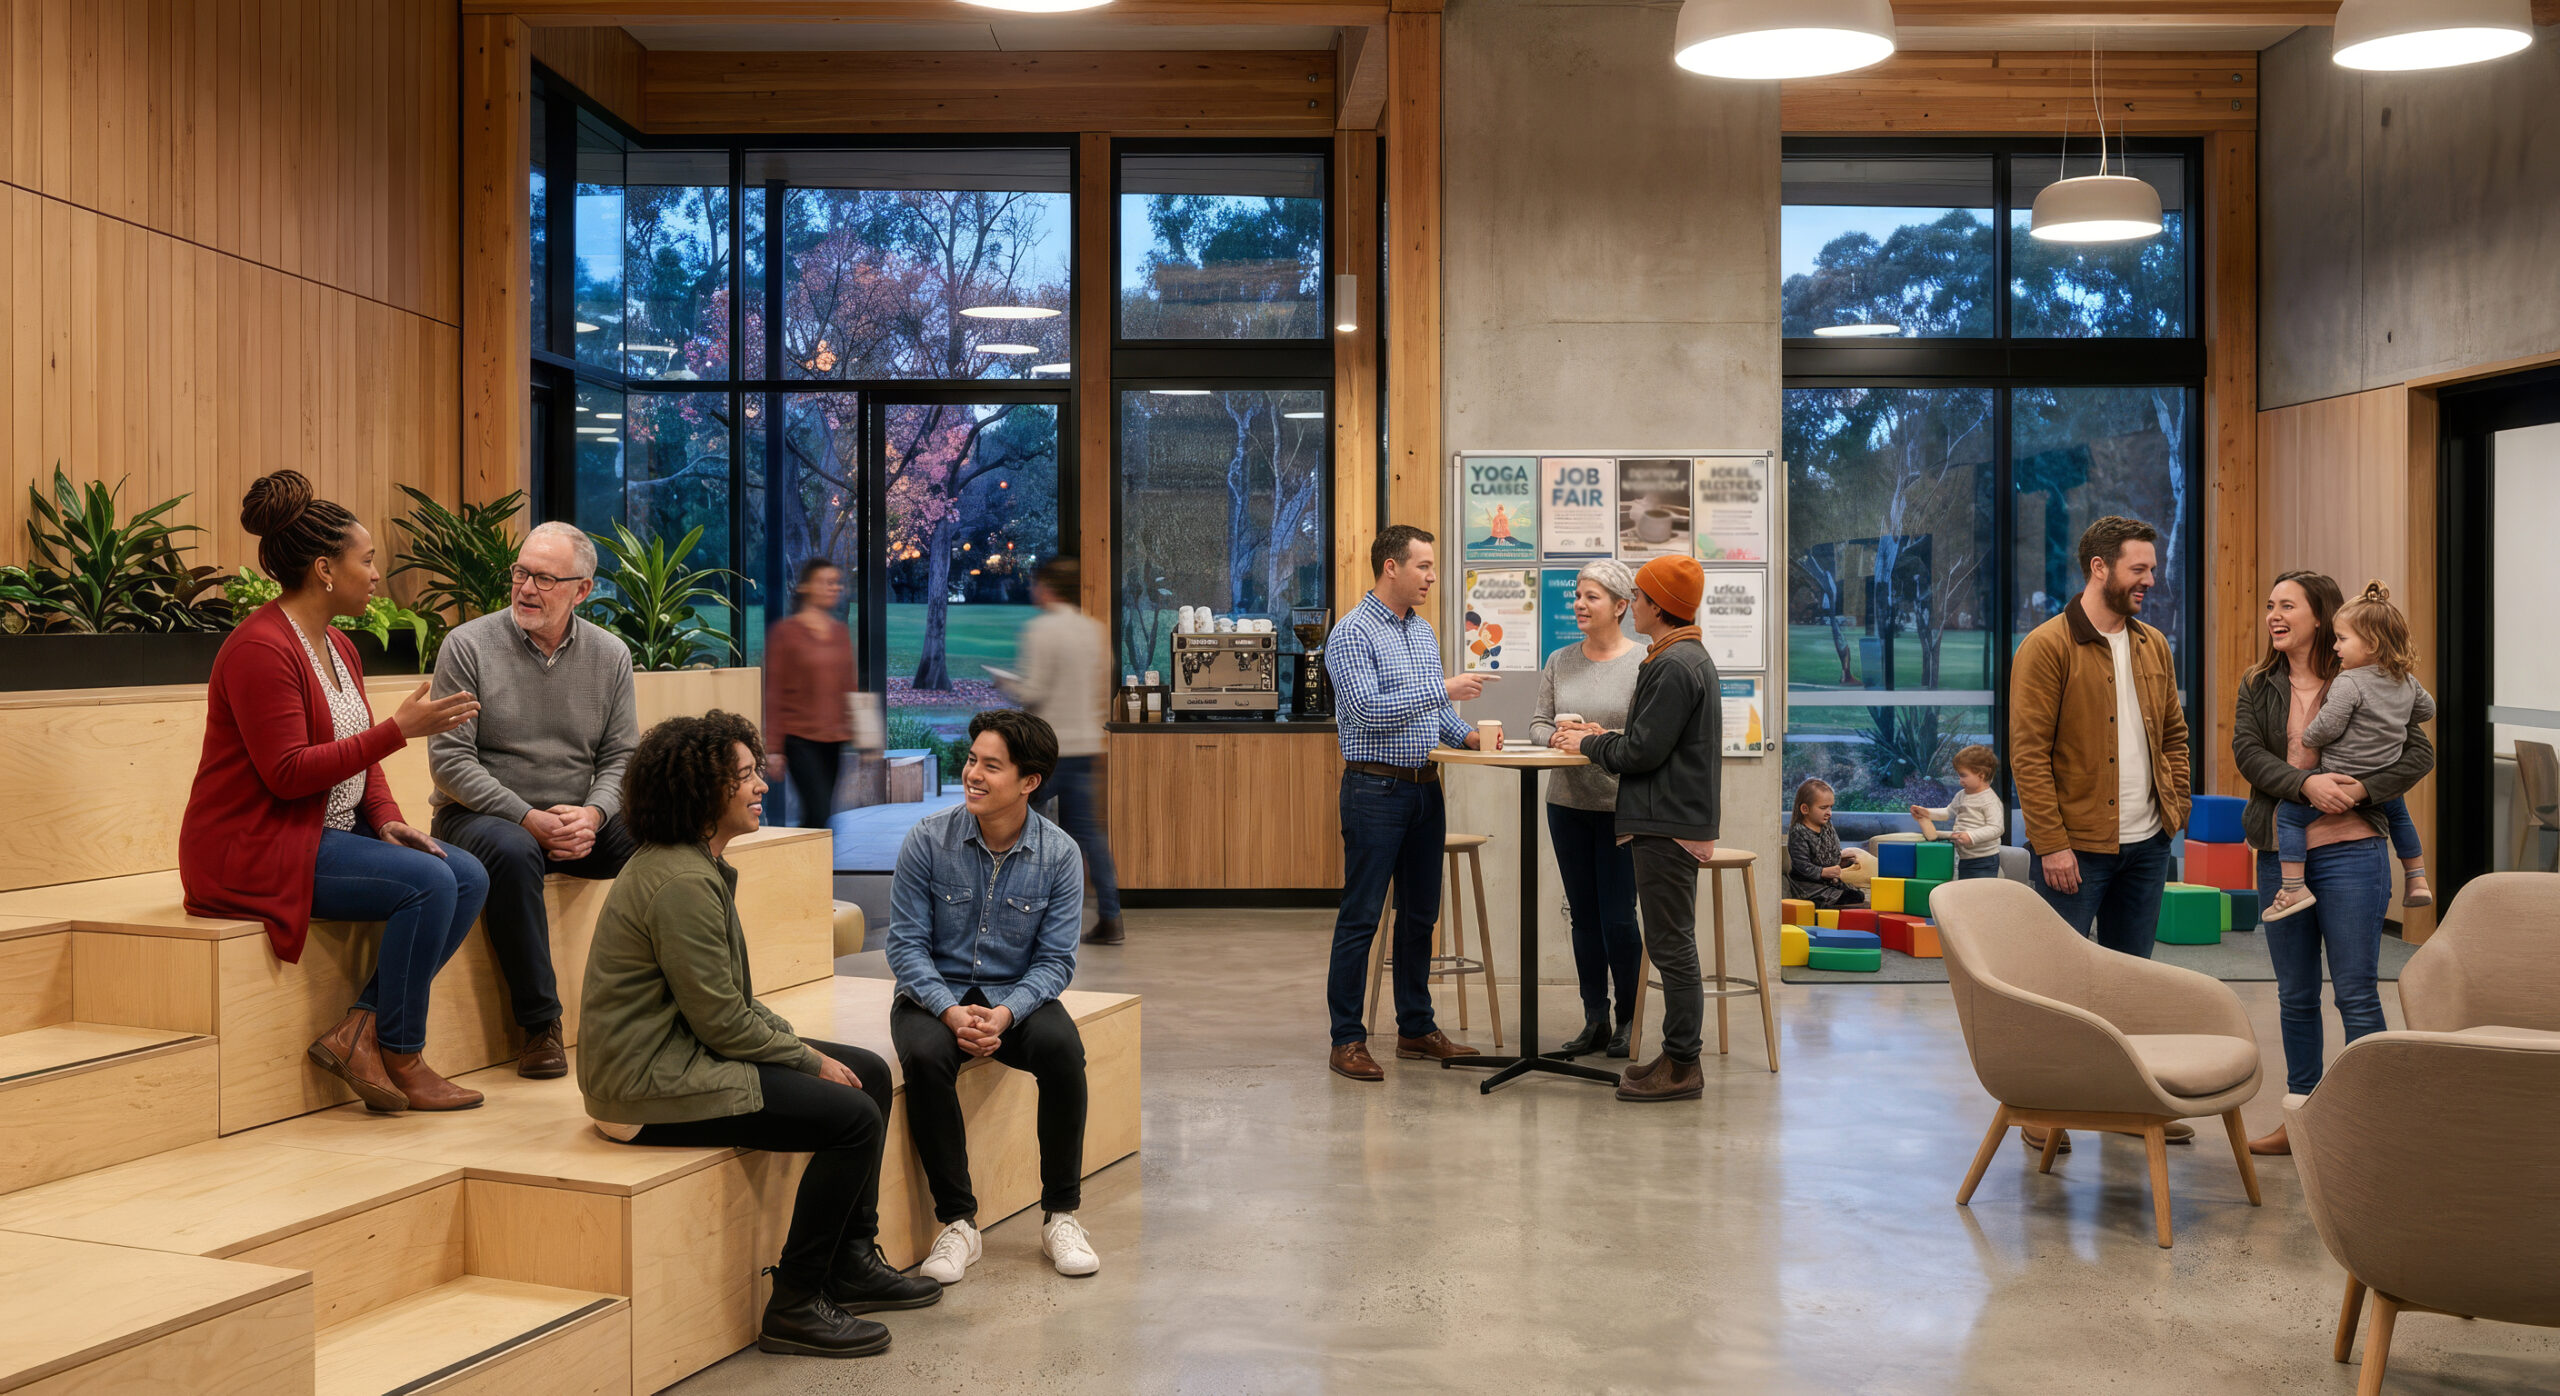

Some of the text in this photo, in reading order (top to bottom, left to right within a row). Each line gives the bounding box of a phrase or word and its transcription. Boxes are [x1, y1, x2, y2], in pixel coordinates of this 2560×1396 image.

[1471, 465, 1528, 481] YOGA
[1554, 467, 1600, 486] JOB
[1552, 488, 1603, 507] FAIR
